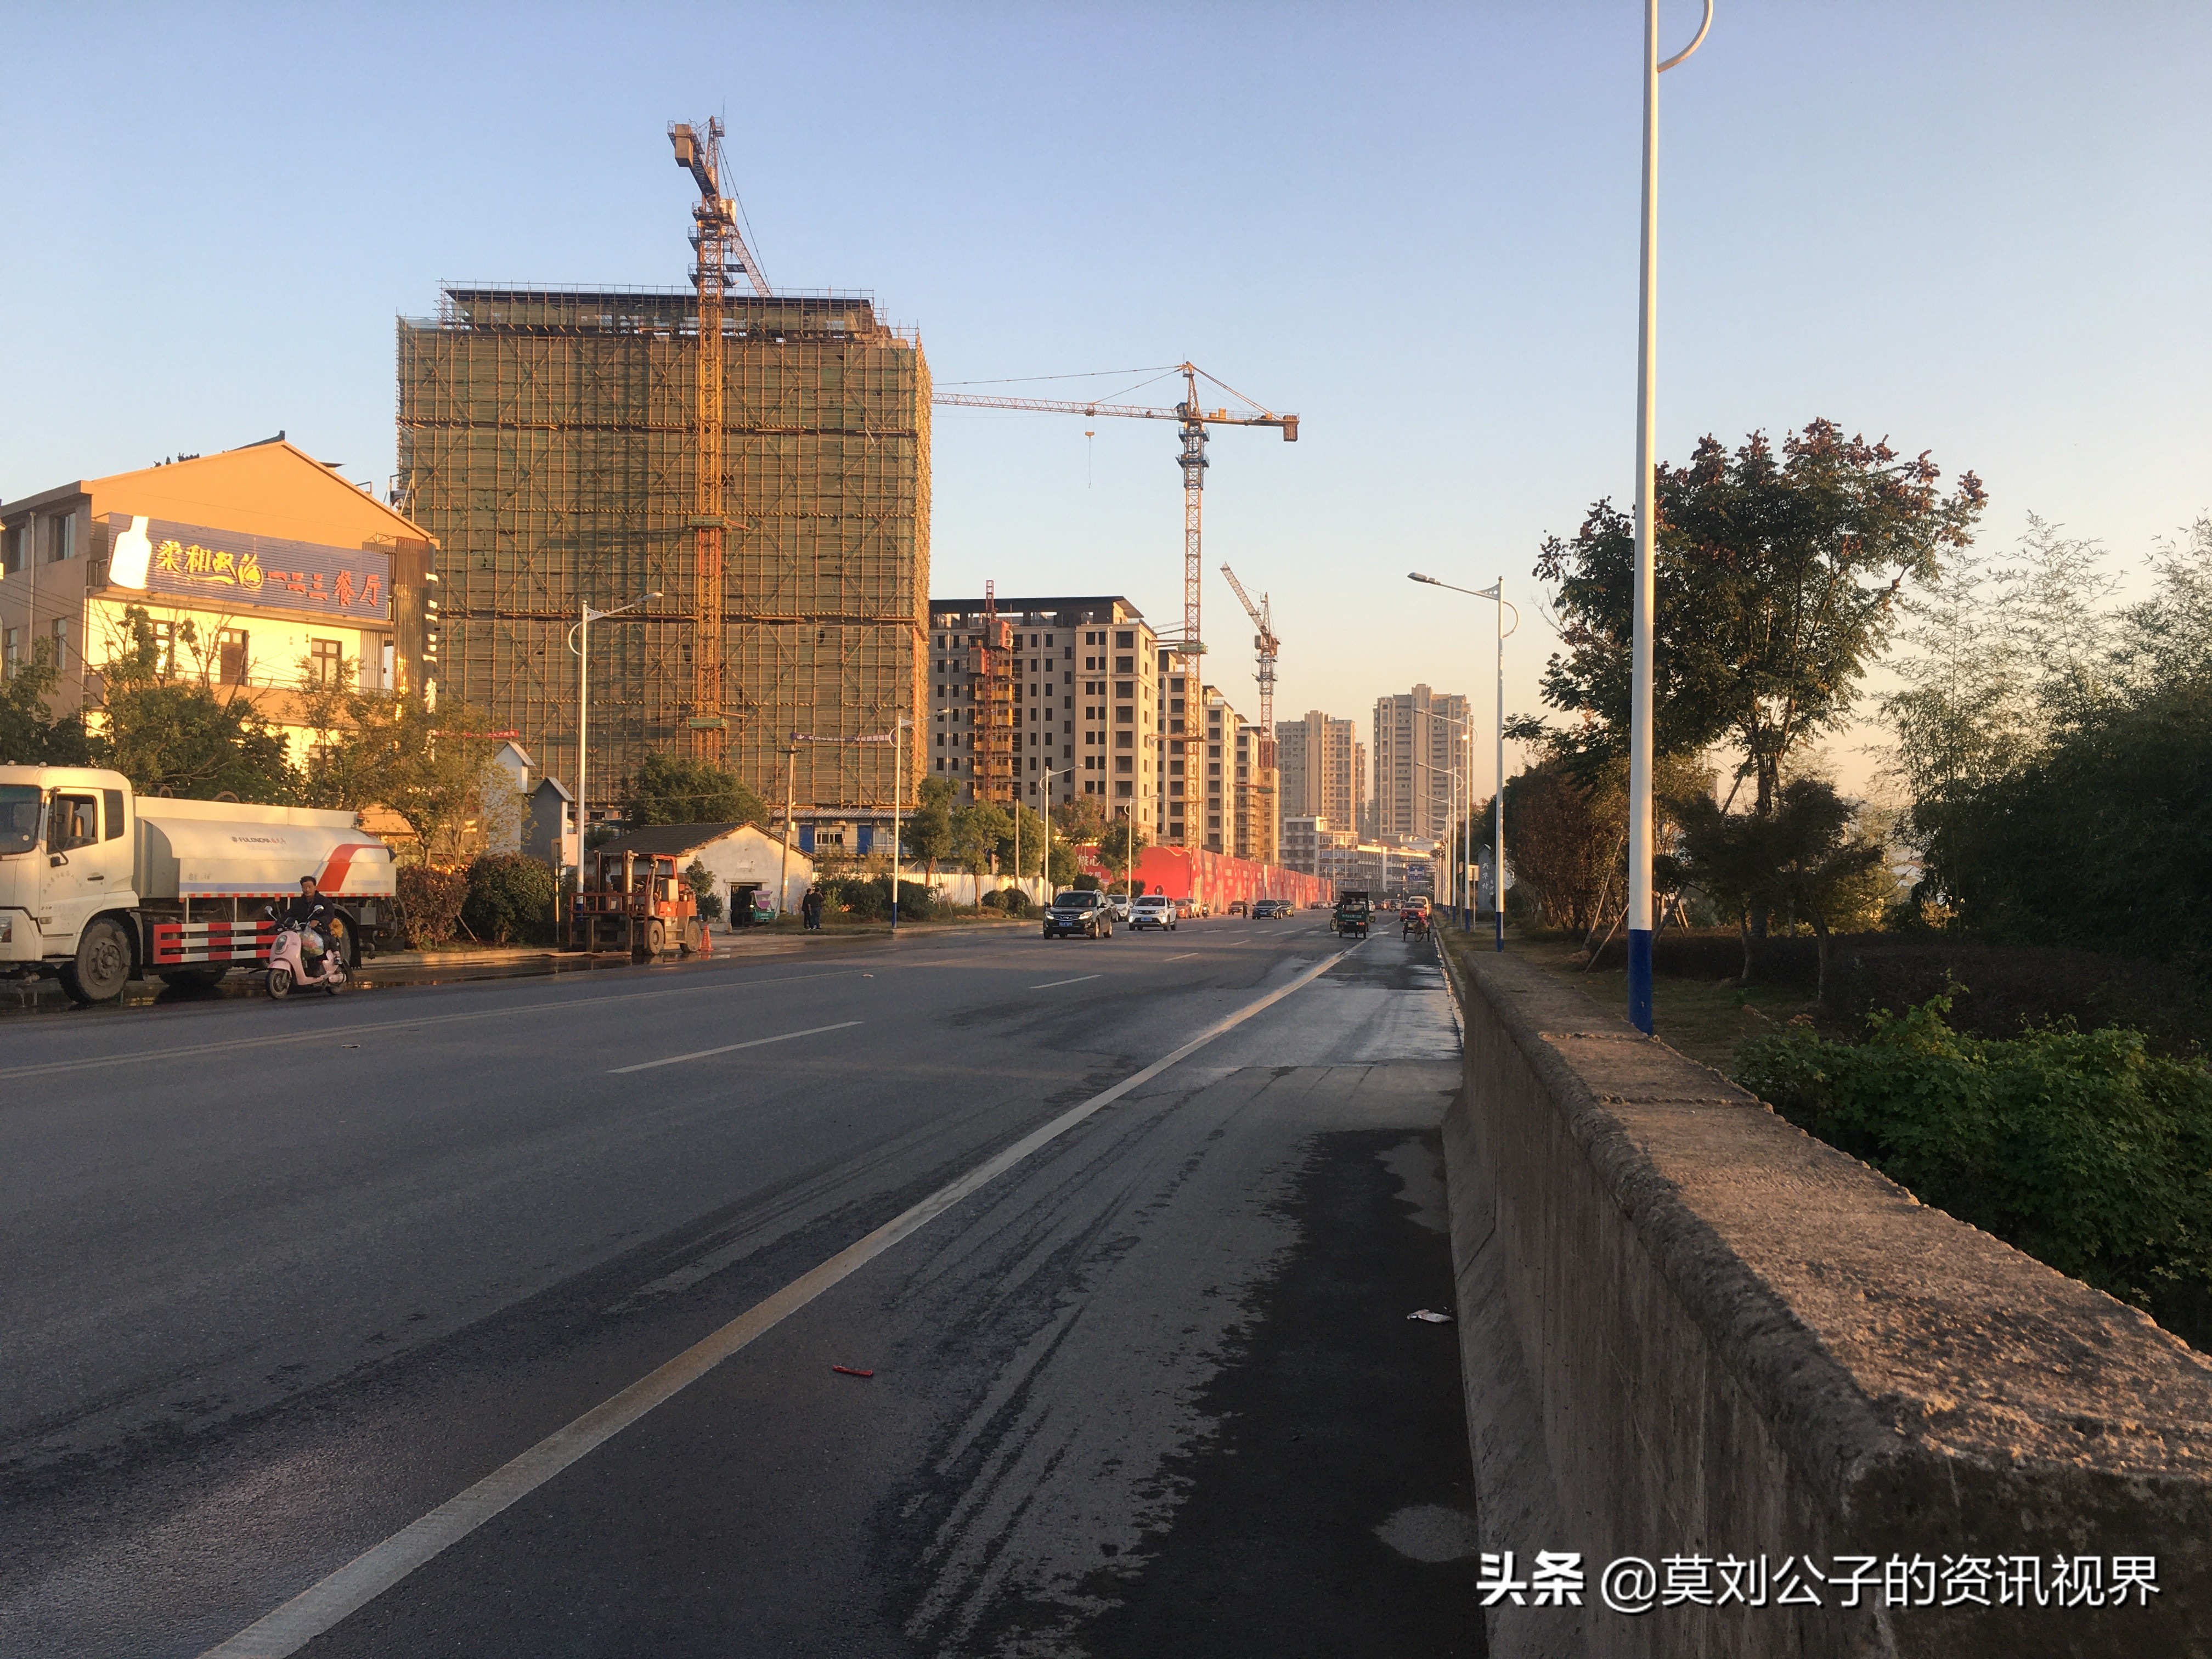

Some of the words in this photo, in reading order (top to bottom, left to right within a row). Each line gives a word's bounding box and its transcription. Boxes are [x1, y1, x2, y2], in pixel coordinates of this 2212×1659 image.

[267, 570, 381, 606] 一二三餐厅
